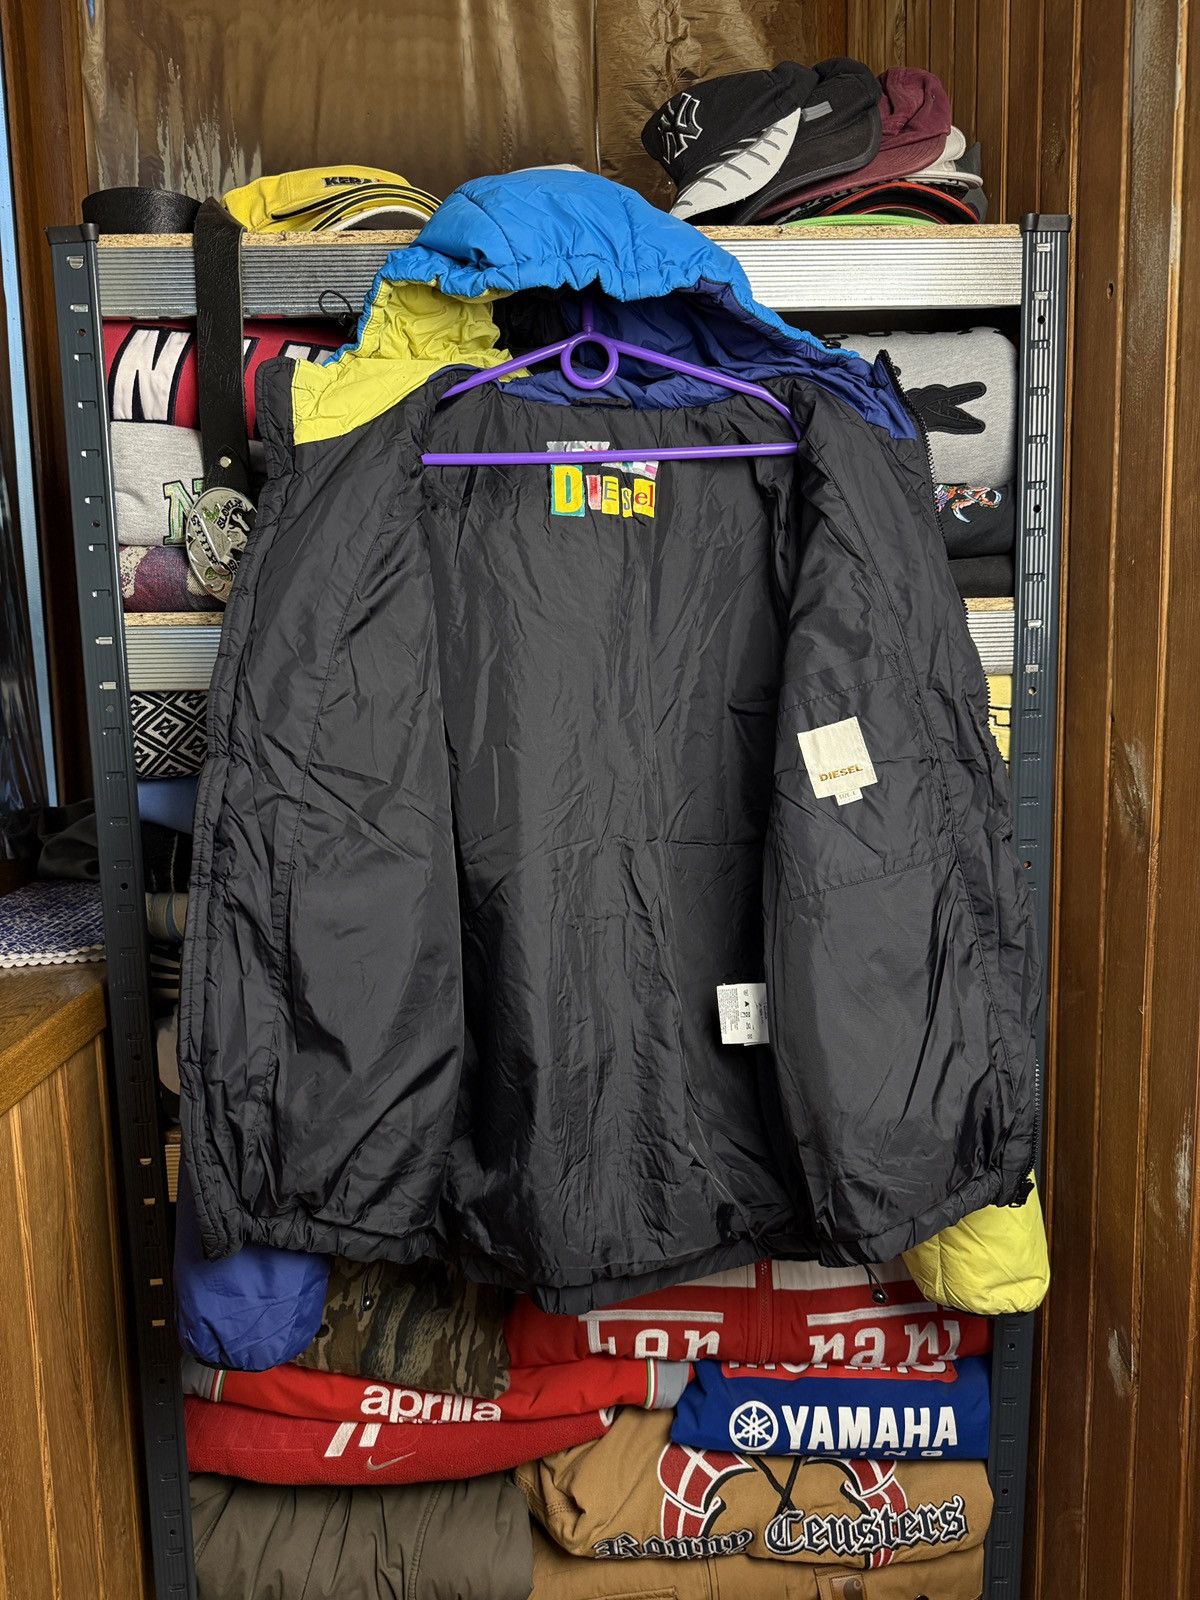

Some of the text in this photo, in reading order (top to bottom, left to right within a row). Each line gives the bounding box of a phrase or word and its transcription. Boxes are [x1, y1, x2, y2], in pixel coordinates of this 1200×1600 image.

[819, 763, 864, 782] DIESEL
[360, 1384, 502, 1423] aprilia
[781, 1405, 958, 1450] YAMAHA
[764, 1494, 969, 1556] Ceusters
